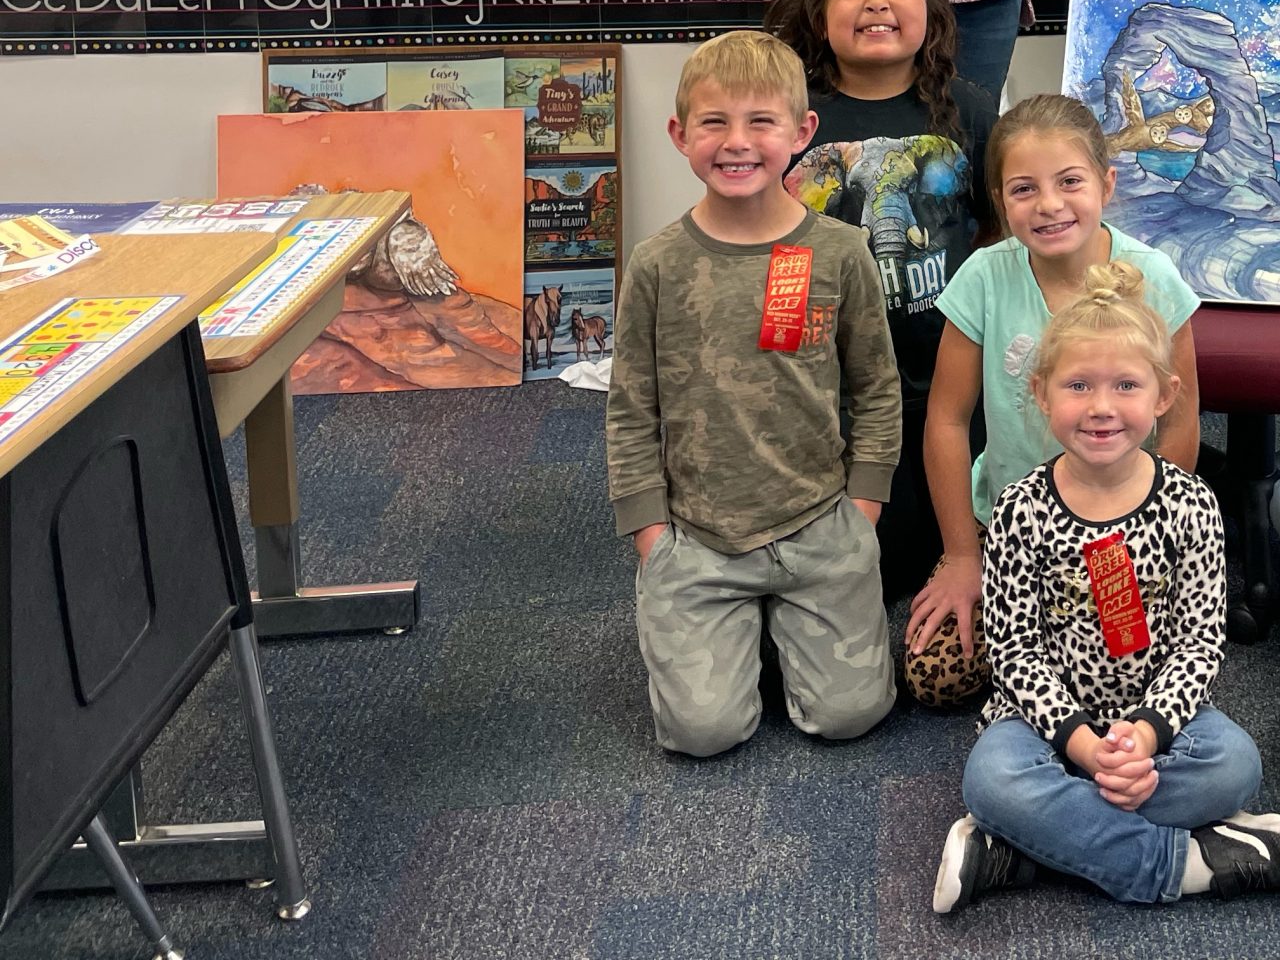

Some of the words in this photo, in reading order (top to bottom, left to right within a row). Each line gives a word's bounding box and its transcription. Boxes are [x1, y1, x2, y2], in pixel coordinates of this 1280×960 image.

[430, 68, 459, 80] Casey
[545, 88, 574, 102] Tiny's
[547, 103, 572, 112] GRAND
[558, 201, 584, 212] Search
[528, 219, 551, 229] TRUTH
[562, 217, 588, 227] BEAUTY
[773, 254, 809, 267] DRUG
[772, 264, 807, 277] FREE
[906, 250, 947, 299] DAY
[771, 278, 806, 286] LOOKS
[770, 285, 804, 295] LIKE
[768, 296, 801, 310] ME
[907, 293, 940, 315] PROTEC
[1093, 550, 1125, 580] FREE
[1096, 566, 1130, 590] LOOKS
[1099, 575, 1131, 600] LIKE
[1103, 589, 1132, 617] ME
